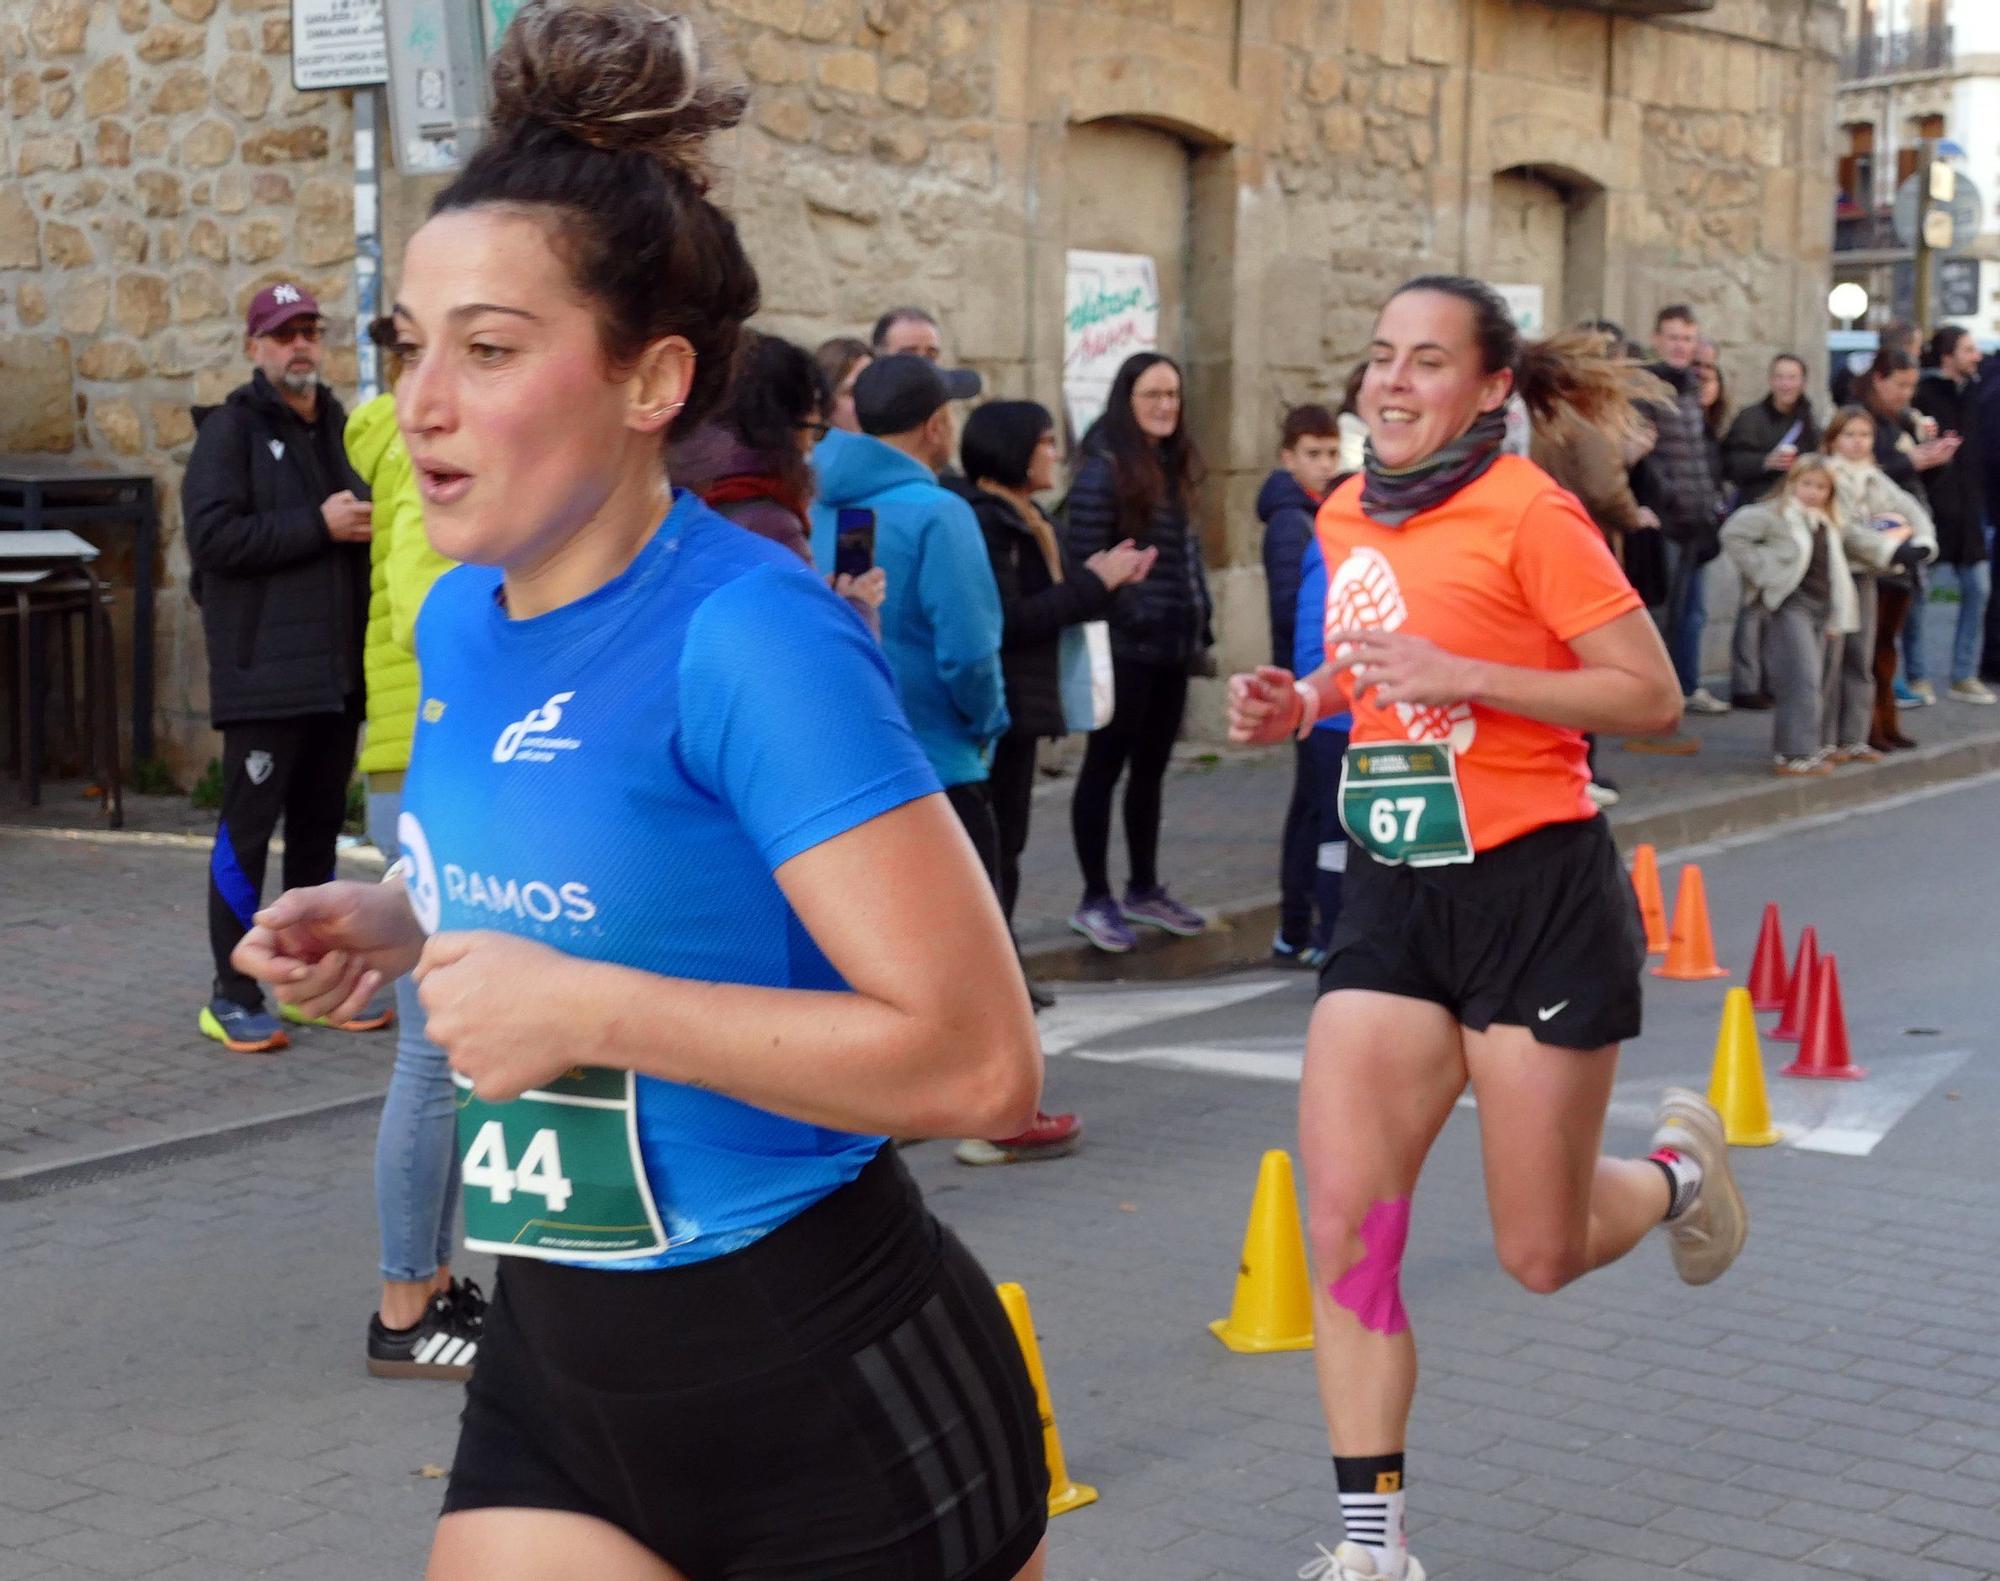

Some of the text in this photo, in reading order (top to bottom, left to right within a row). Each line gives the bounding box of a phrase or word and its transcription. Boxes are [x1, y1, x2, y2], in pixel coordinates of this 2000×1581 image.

[1369, 797, 1427, 844] 67
[443, 863, 597, 923] RAMOS
[462, 1120, 574, 1213] 44
